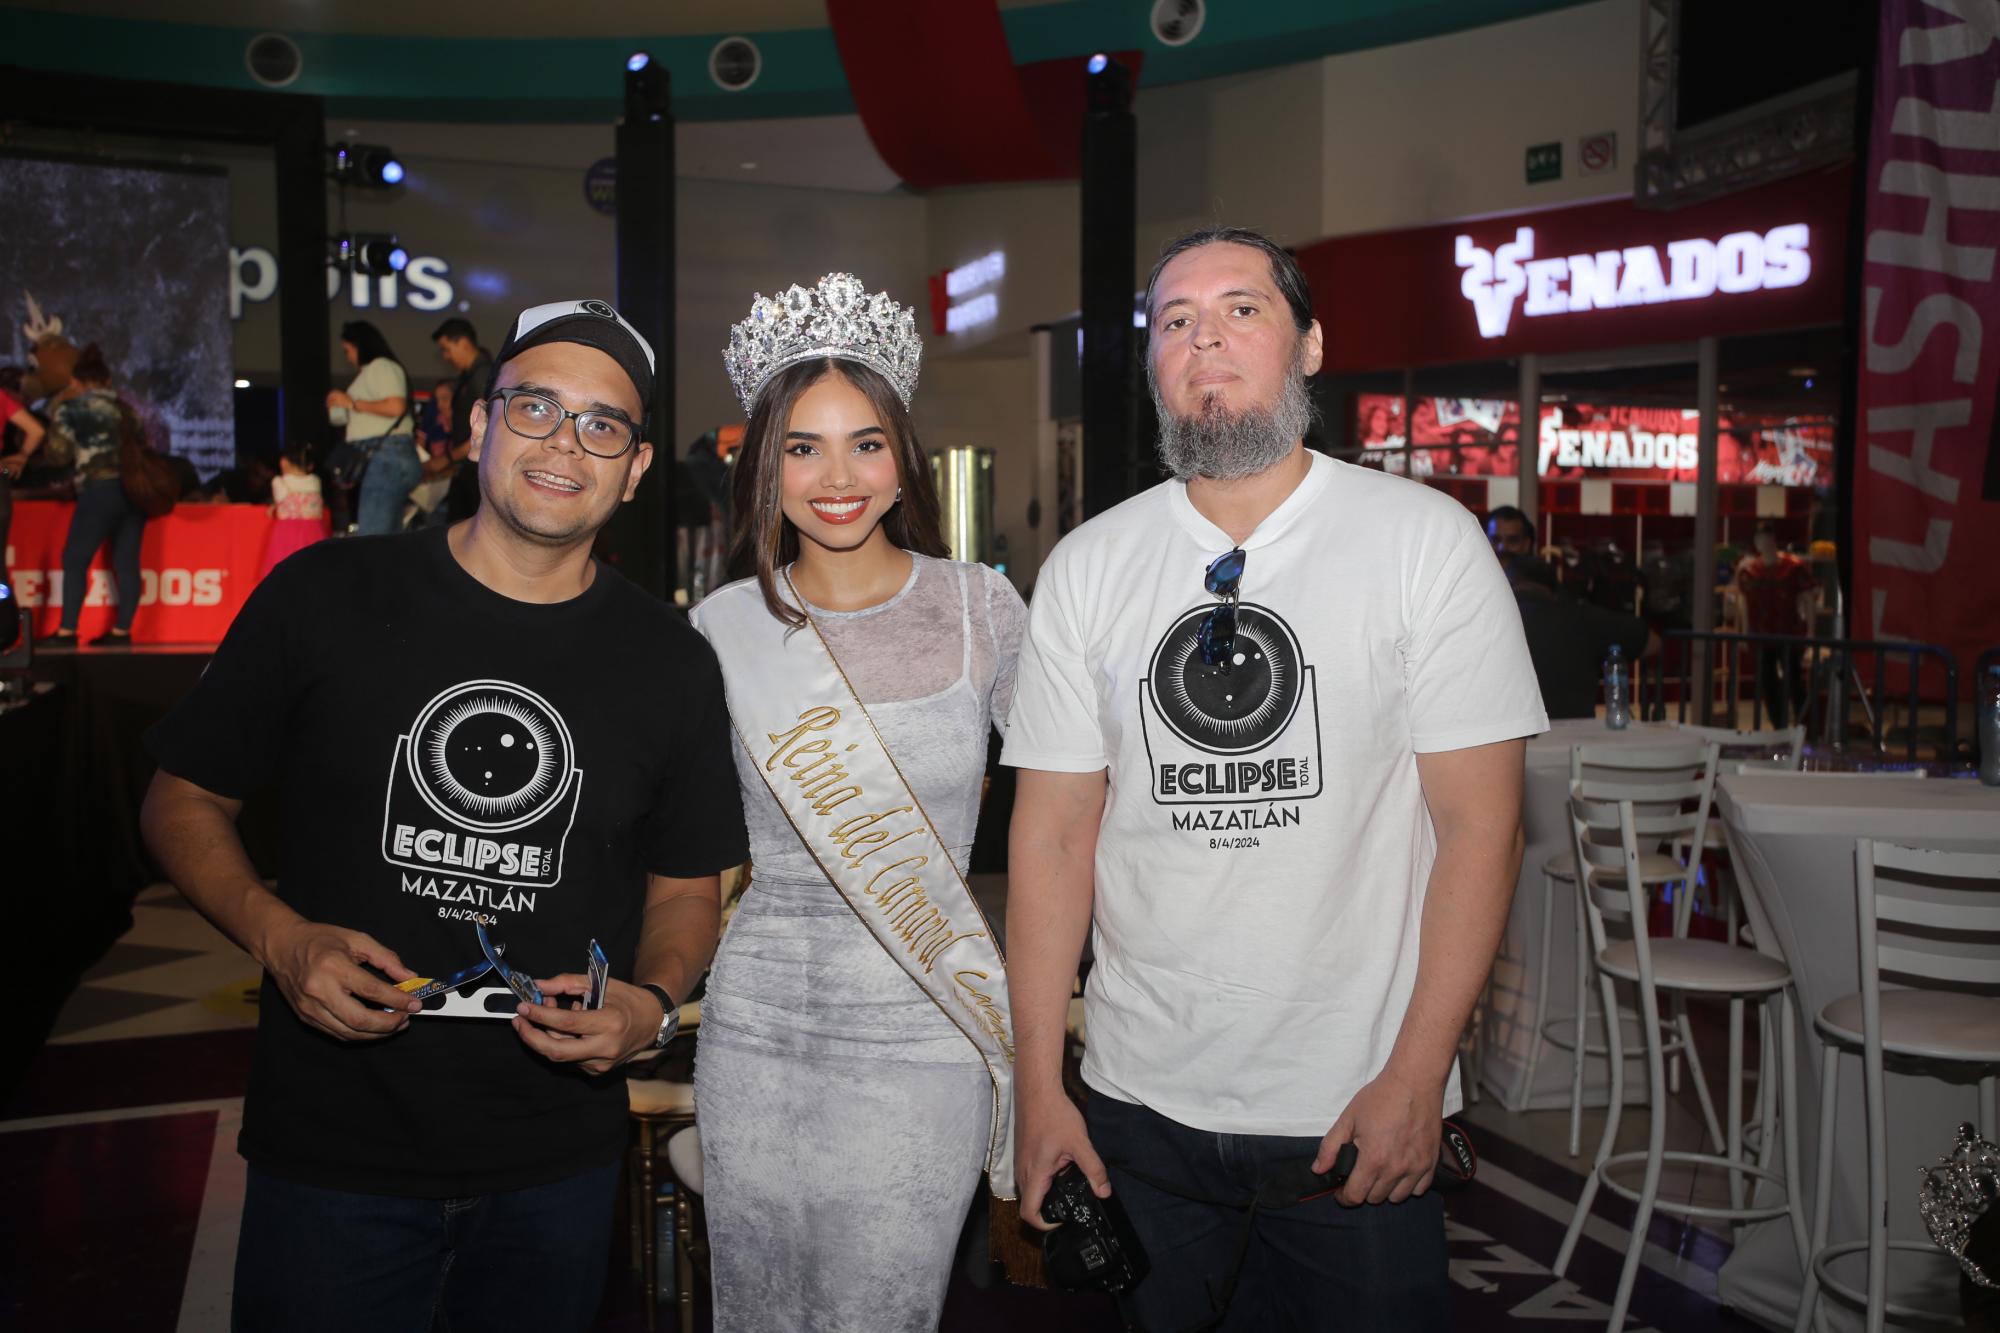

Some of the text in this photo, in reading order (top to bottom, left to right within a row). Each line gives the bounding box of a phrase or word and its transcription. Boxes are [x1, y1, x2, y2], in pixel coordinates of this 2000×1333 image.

[1160, 758, 1297, 795] ECLIPSE
[1299, 756, 1309, 788] TOTAL
[1172, 802, 1300, 831] MAZATLÁN
[393, 824, 542, 878] ECLIPSE
[766, 706, 986, 975] Reina del Carnaval
[1209, 837, 1260, 850] 8/4/2024
[540, 848, 553, 877] TOTAL
[401, 872, 536, 913] MAZATLÁN
